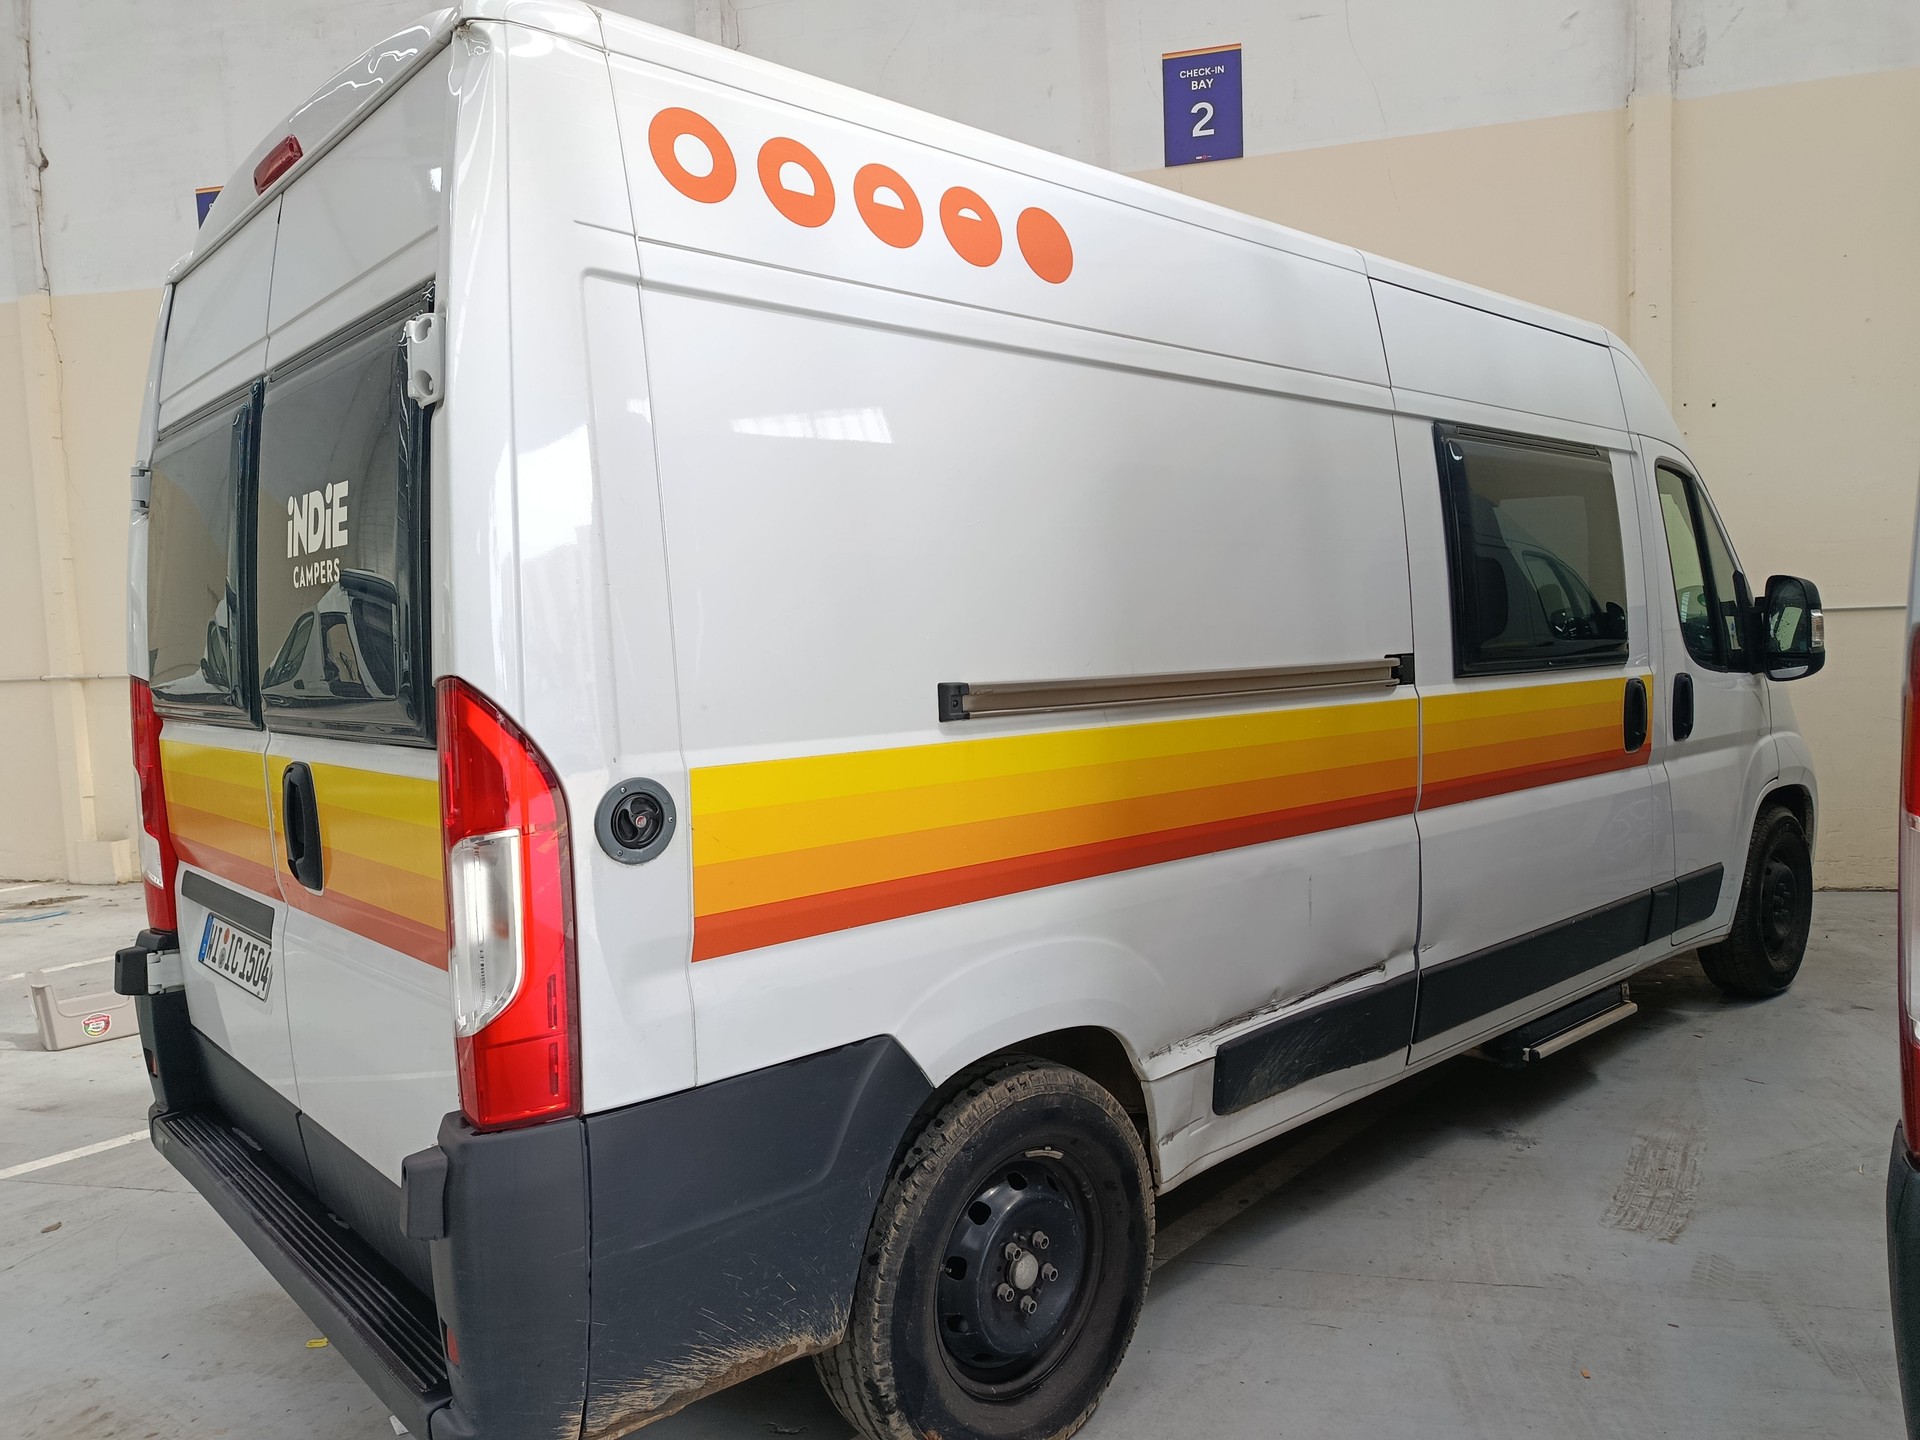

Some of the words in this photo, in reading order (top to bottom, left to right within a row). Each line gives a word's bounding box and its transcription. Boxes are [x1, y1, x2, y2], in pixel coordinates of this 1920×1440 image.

[1179, 65, 1225, 79] CHECK-IN
[1191, 78, 1214, 91] BAY
[1190, 101, 1215, 137] 2
[293, 557, 340, 589] CAMPERS
[224, 933, 243, 975] IC
[238, 941, 272, 992] 1504
